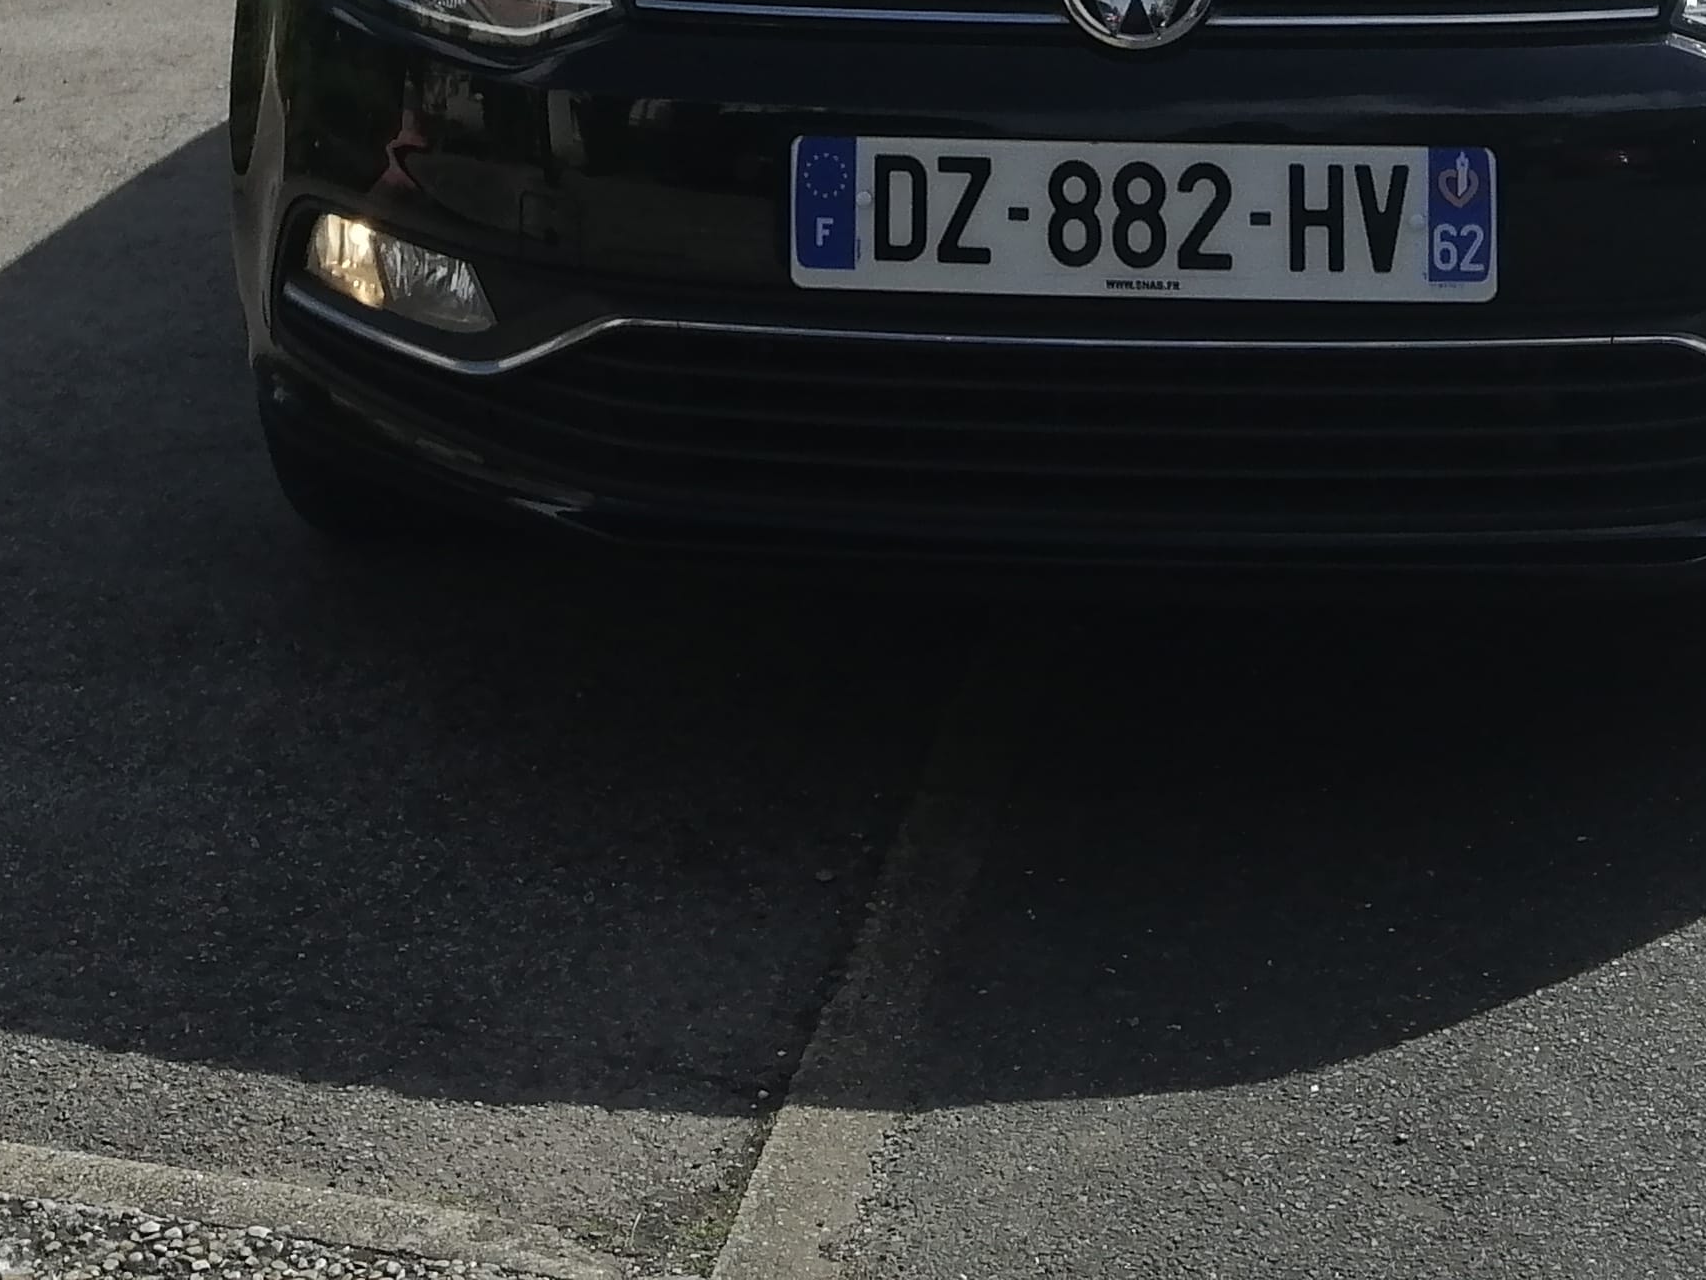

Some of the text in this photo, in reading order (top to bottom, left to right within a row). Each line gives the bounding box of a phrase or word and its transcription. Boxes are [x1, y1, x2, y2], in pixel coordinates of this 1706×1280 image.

[816, 217, 834, 247] F
[874, 154, 1409, 273] DZ-882-HV
[1433, 223, 1486, 272] 62
